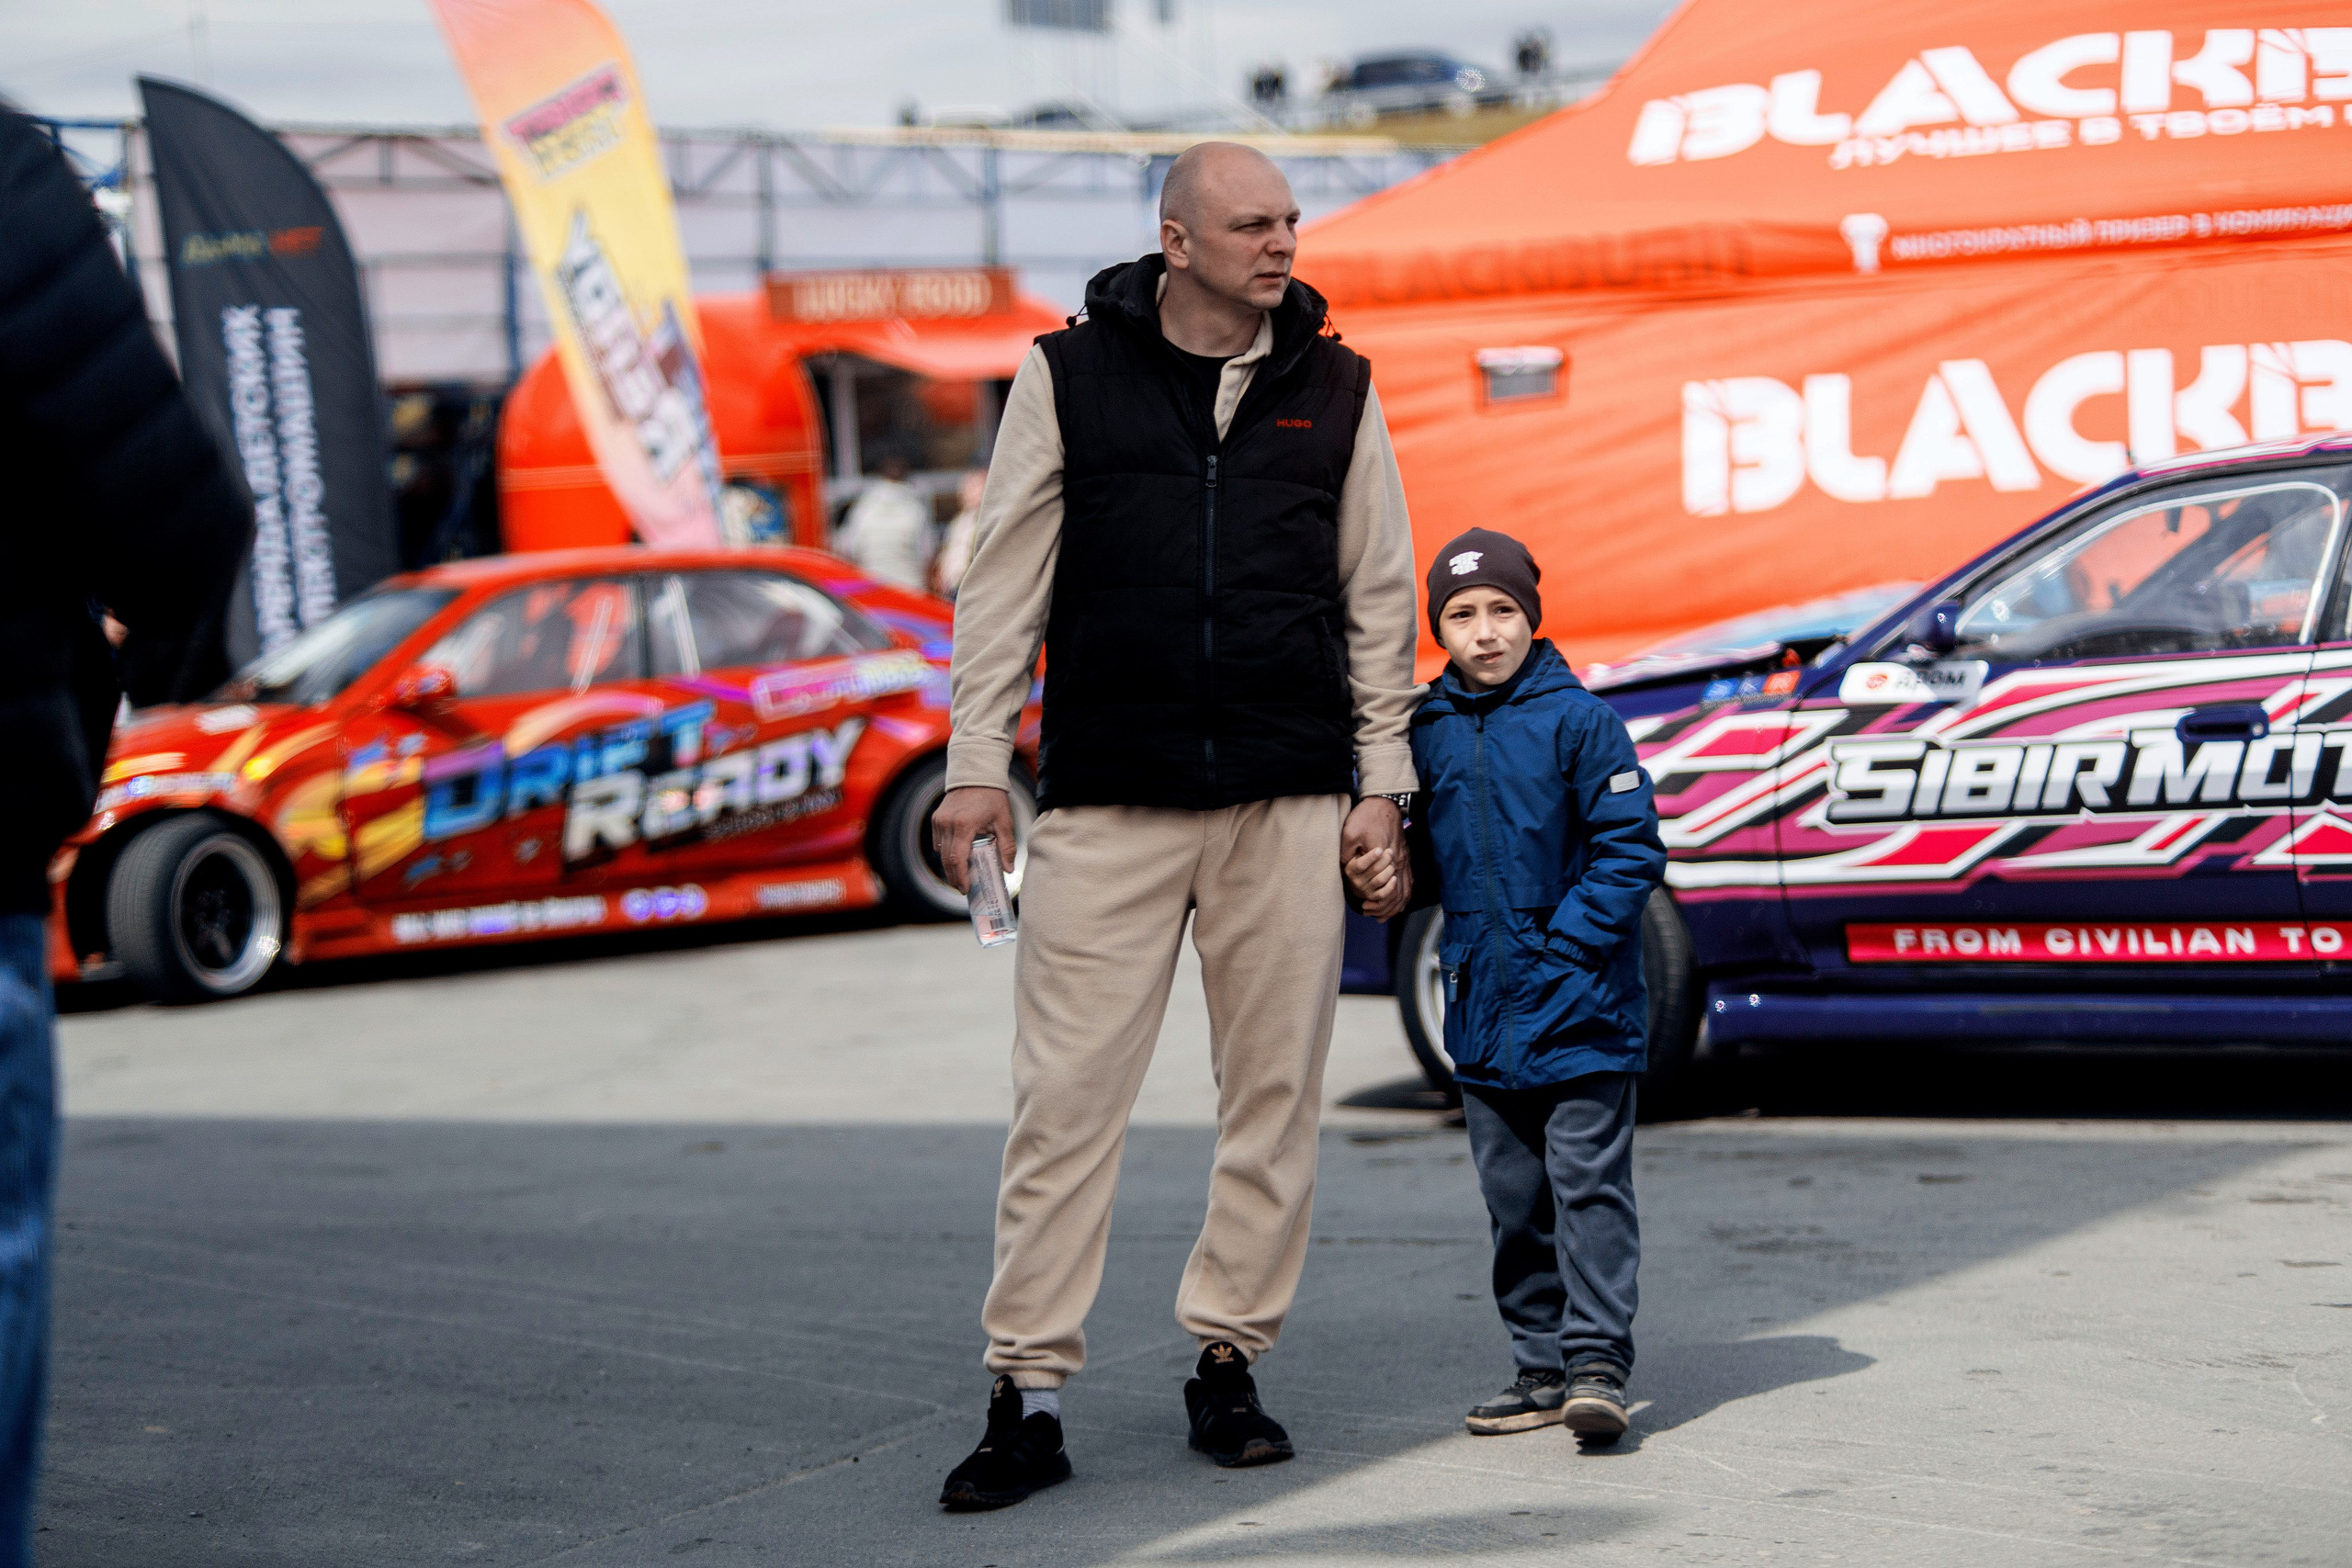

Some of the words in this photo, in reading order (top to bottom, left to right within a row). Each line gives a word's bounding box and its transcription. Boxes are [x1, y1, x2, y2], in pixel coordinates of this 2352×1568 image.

[1828, 119, 2071, 169] ЛУЧШЕЕ
[2078, 117, 2121, 145] В
[2131, 104, 2333, 141] ТВОЁМ
[1276, 418, 1313, 429] HUGO
[562, 716, 867, 863] READY
[1827, 739, 2127, 821] SIBIR
[1894, 928, 2020, 954] FROM
[2044, 928, 2256, 954] CIVILIAN
[2280, 927, 2343, 953] TO
